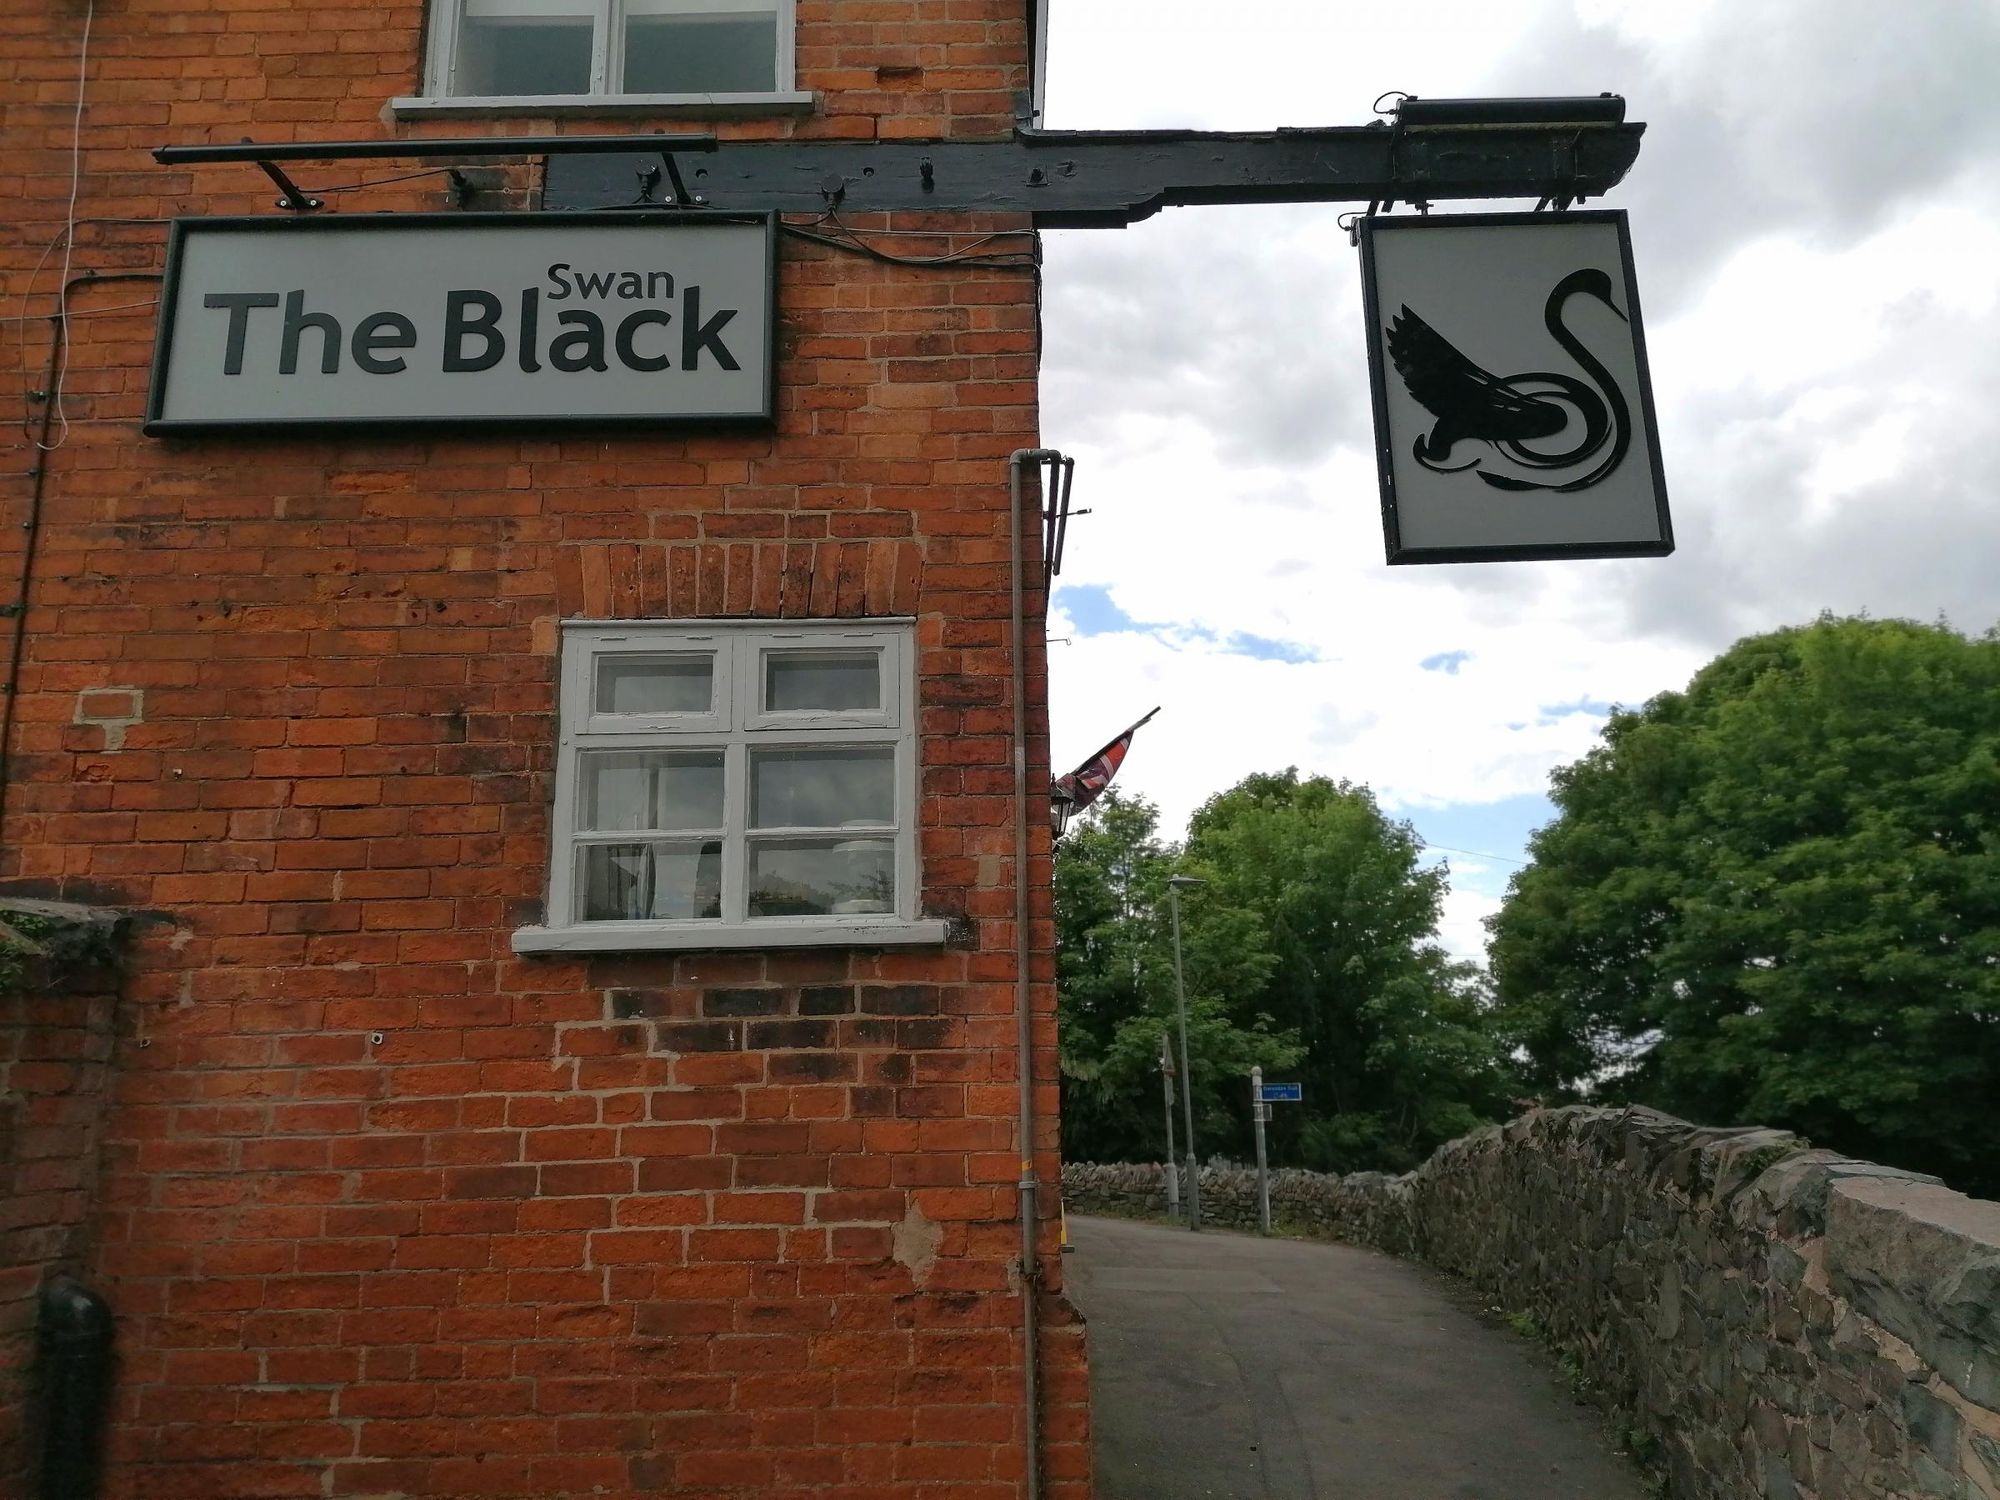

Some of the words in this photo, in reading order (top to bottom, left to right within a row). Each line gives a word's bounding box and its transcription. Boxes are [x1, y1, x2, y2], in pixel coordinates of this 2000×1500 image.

[547, 263, 675, 300] Swan
[204, 289, 417, 375] The
[442, 286, 742, 373] Black
